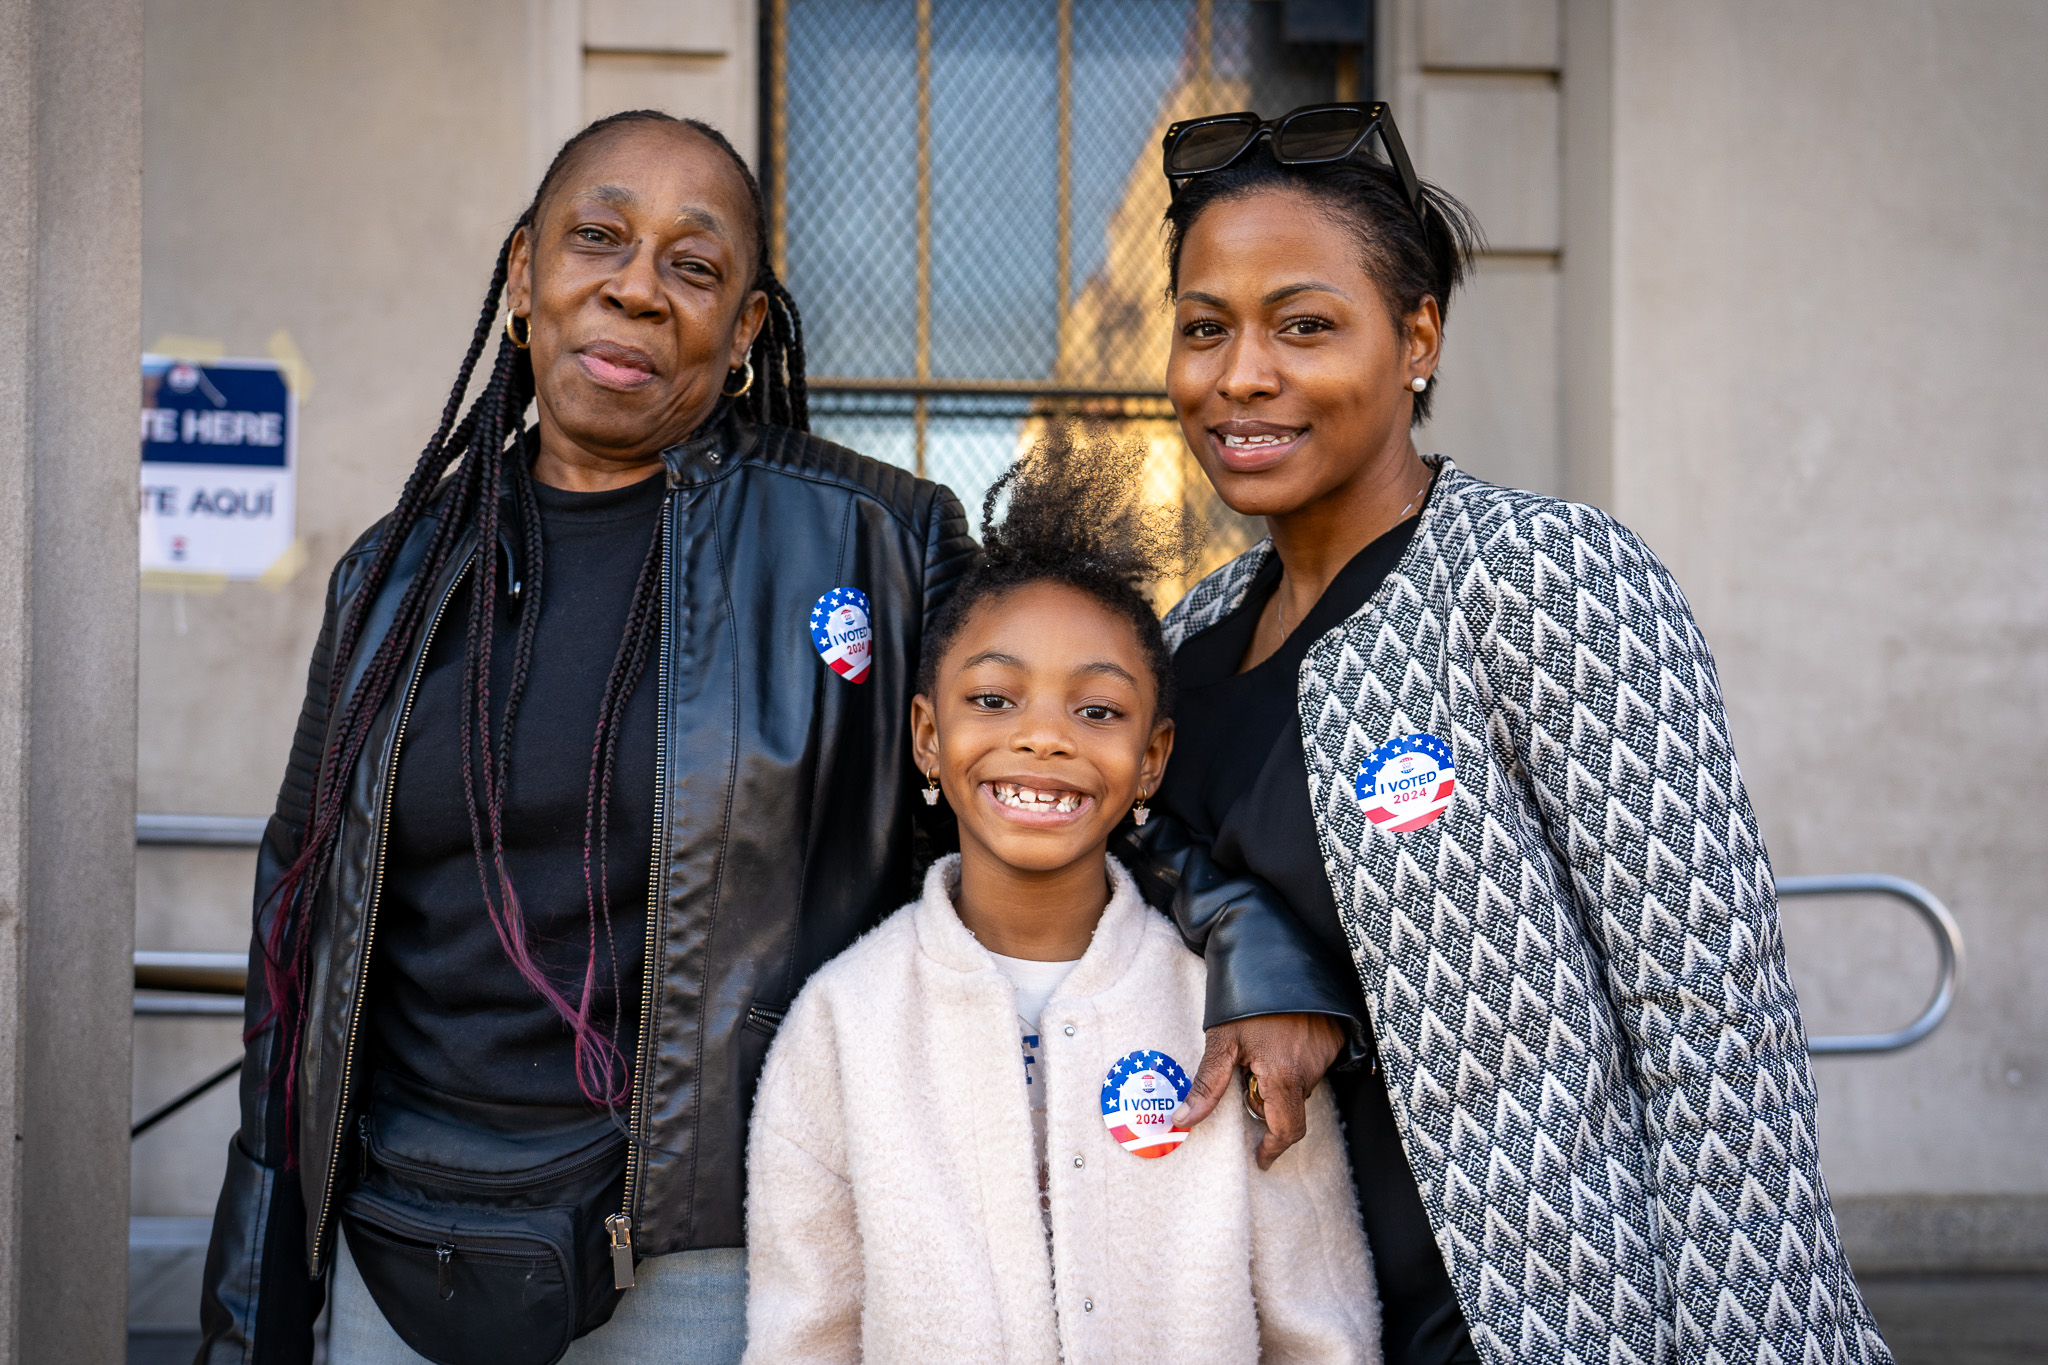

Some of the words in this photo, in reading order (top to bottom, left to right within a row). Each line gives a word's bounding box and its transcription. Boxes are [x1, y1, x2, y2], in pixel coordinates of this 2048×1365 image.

[141, 408, 179, 443] TE
[181, 410, 283, 447] HERE
[141, 486, 178, 517] TE
[191, 483, 275, 519] AQUÍ
[833, 635, 839, 645] I
[839, 626, 868, 643] VOTED
[847, 642, 865, 655] 2024
[1380, 783, 1385, 795] I
[1388, 771, 1437, 793] VOTED
[1394, 787, 1427, 805] 2024
[1124, 1099, 1128, 1111] I
[1131, 1098, 1175, 1111] VOTED
[1136, 1113, 1165, 1125] 2024
